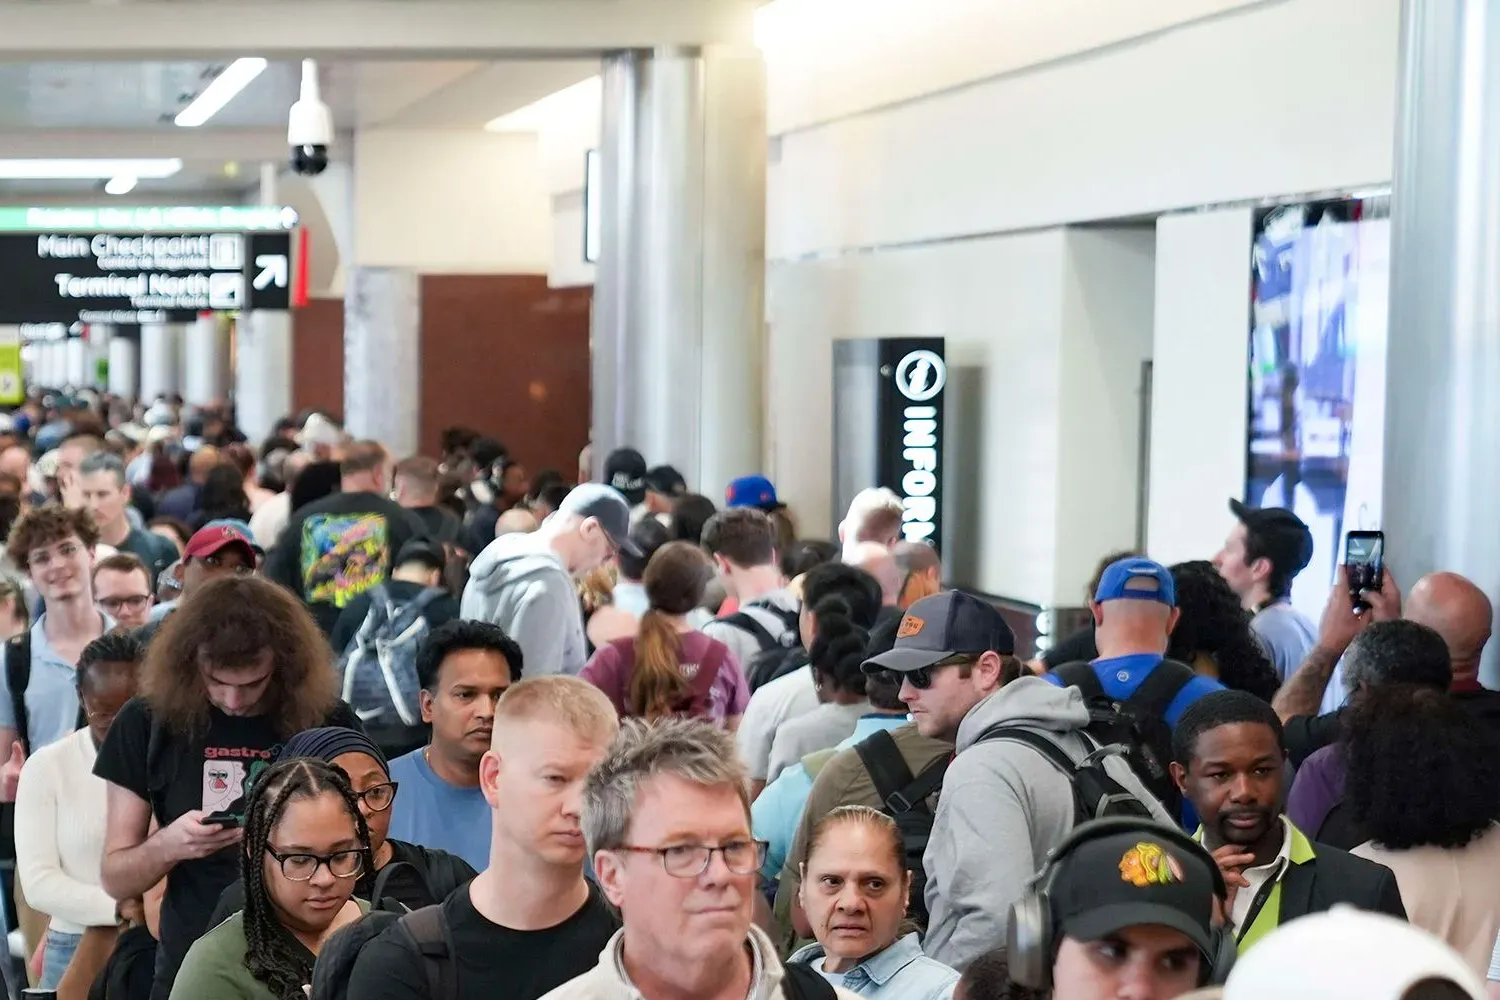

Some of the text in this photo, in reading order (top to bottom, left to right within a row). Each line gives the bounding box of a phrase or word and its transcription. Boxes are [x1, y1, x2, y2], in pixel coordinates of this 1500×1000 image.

[38, 232, 209, 262] Main Checkpoint
[54, 273, 209, 297] Terminal North
[204, 747, 271, 759] gastro
